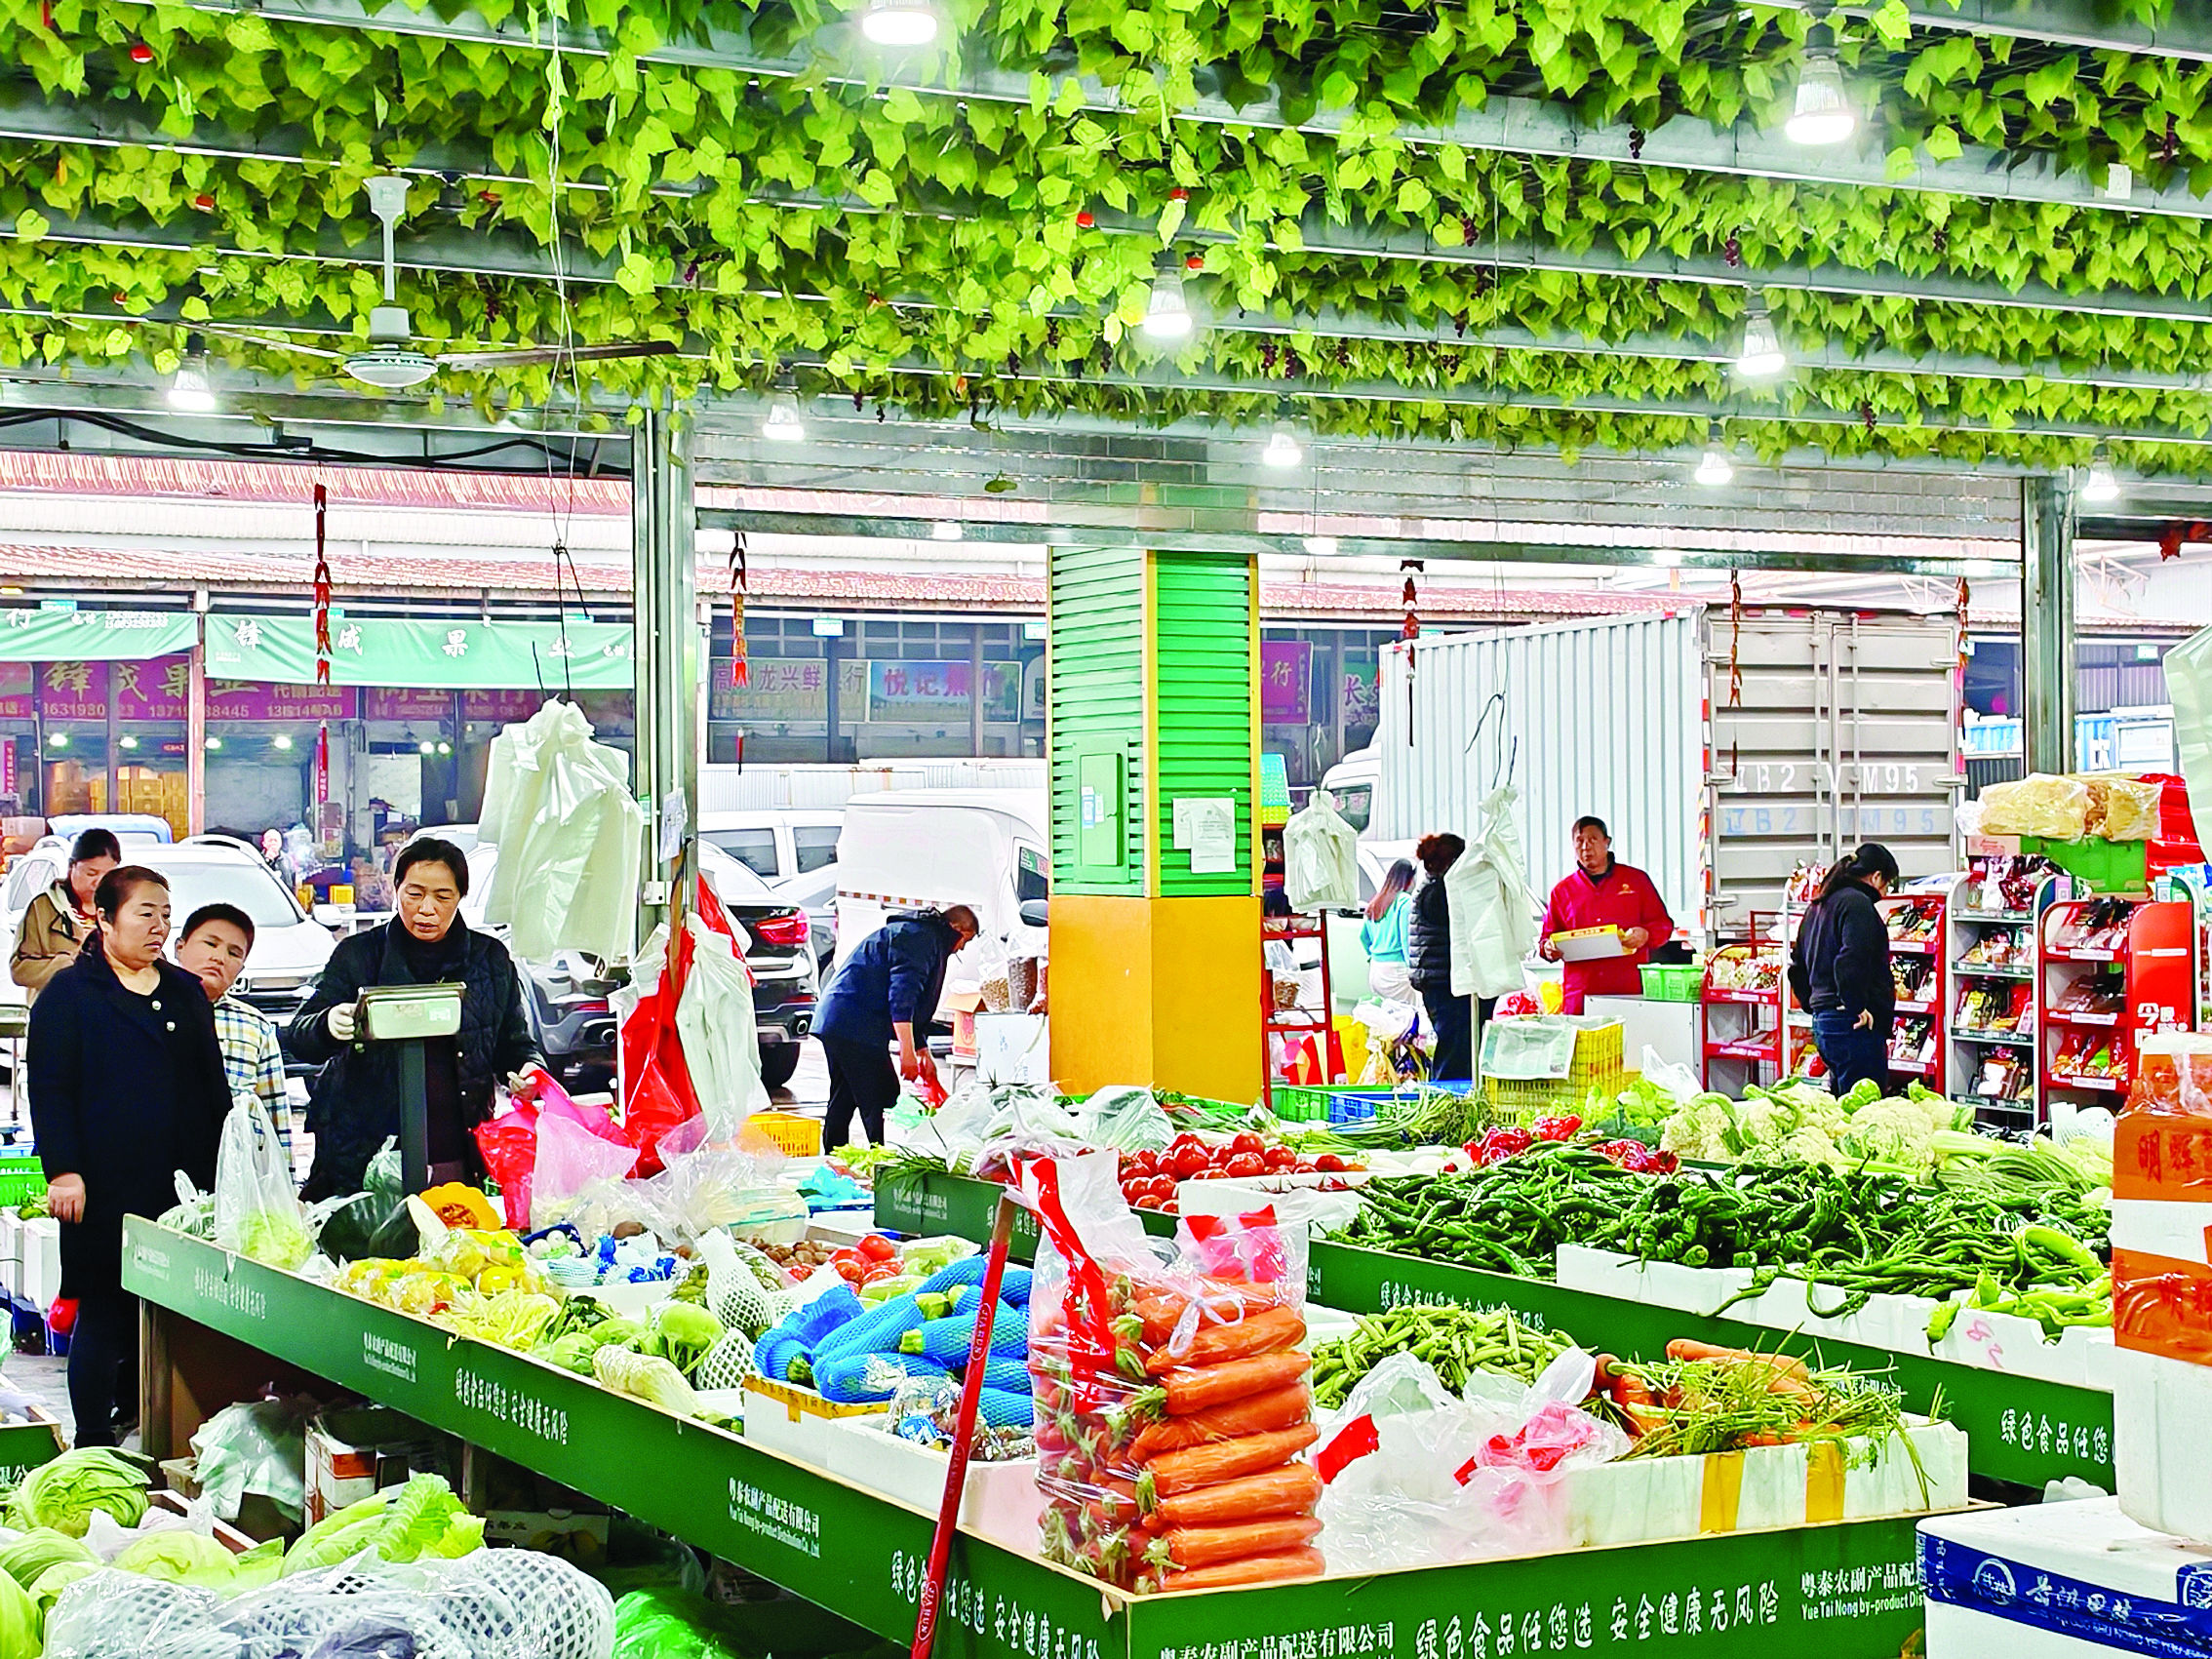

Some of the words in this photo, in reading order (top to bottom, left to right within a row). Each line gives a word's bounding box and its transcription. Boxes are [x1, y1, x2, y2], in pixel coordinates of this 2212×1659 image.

[2000, 1408, 2115, 1464] 绿色食品任您
[891, 1550, 986, 1636] 绿色食任您选
[1801, 1562, 1918, 1599] 粤泰农副产品配
[1802, 1602, 1819, 1621] Yue
[1820, 1600, 1835, 1618] Tai
[1835, 1600, 1859, 1618] Nong
[1859, 1593, 1909, 1617] by-product
[1416, 1601, 1593, 1659] 绿色食品任您选
[1610, 1579, 1779, 1641] 安全健康无风险
